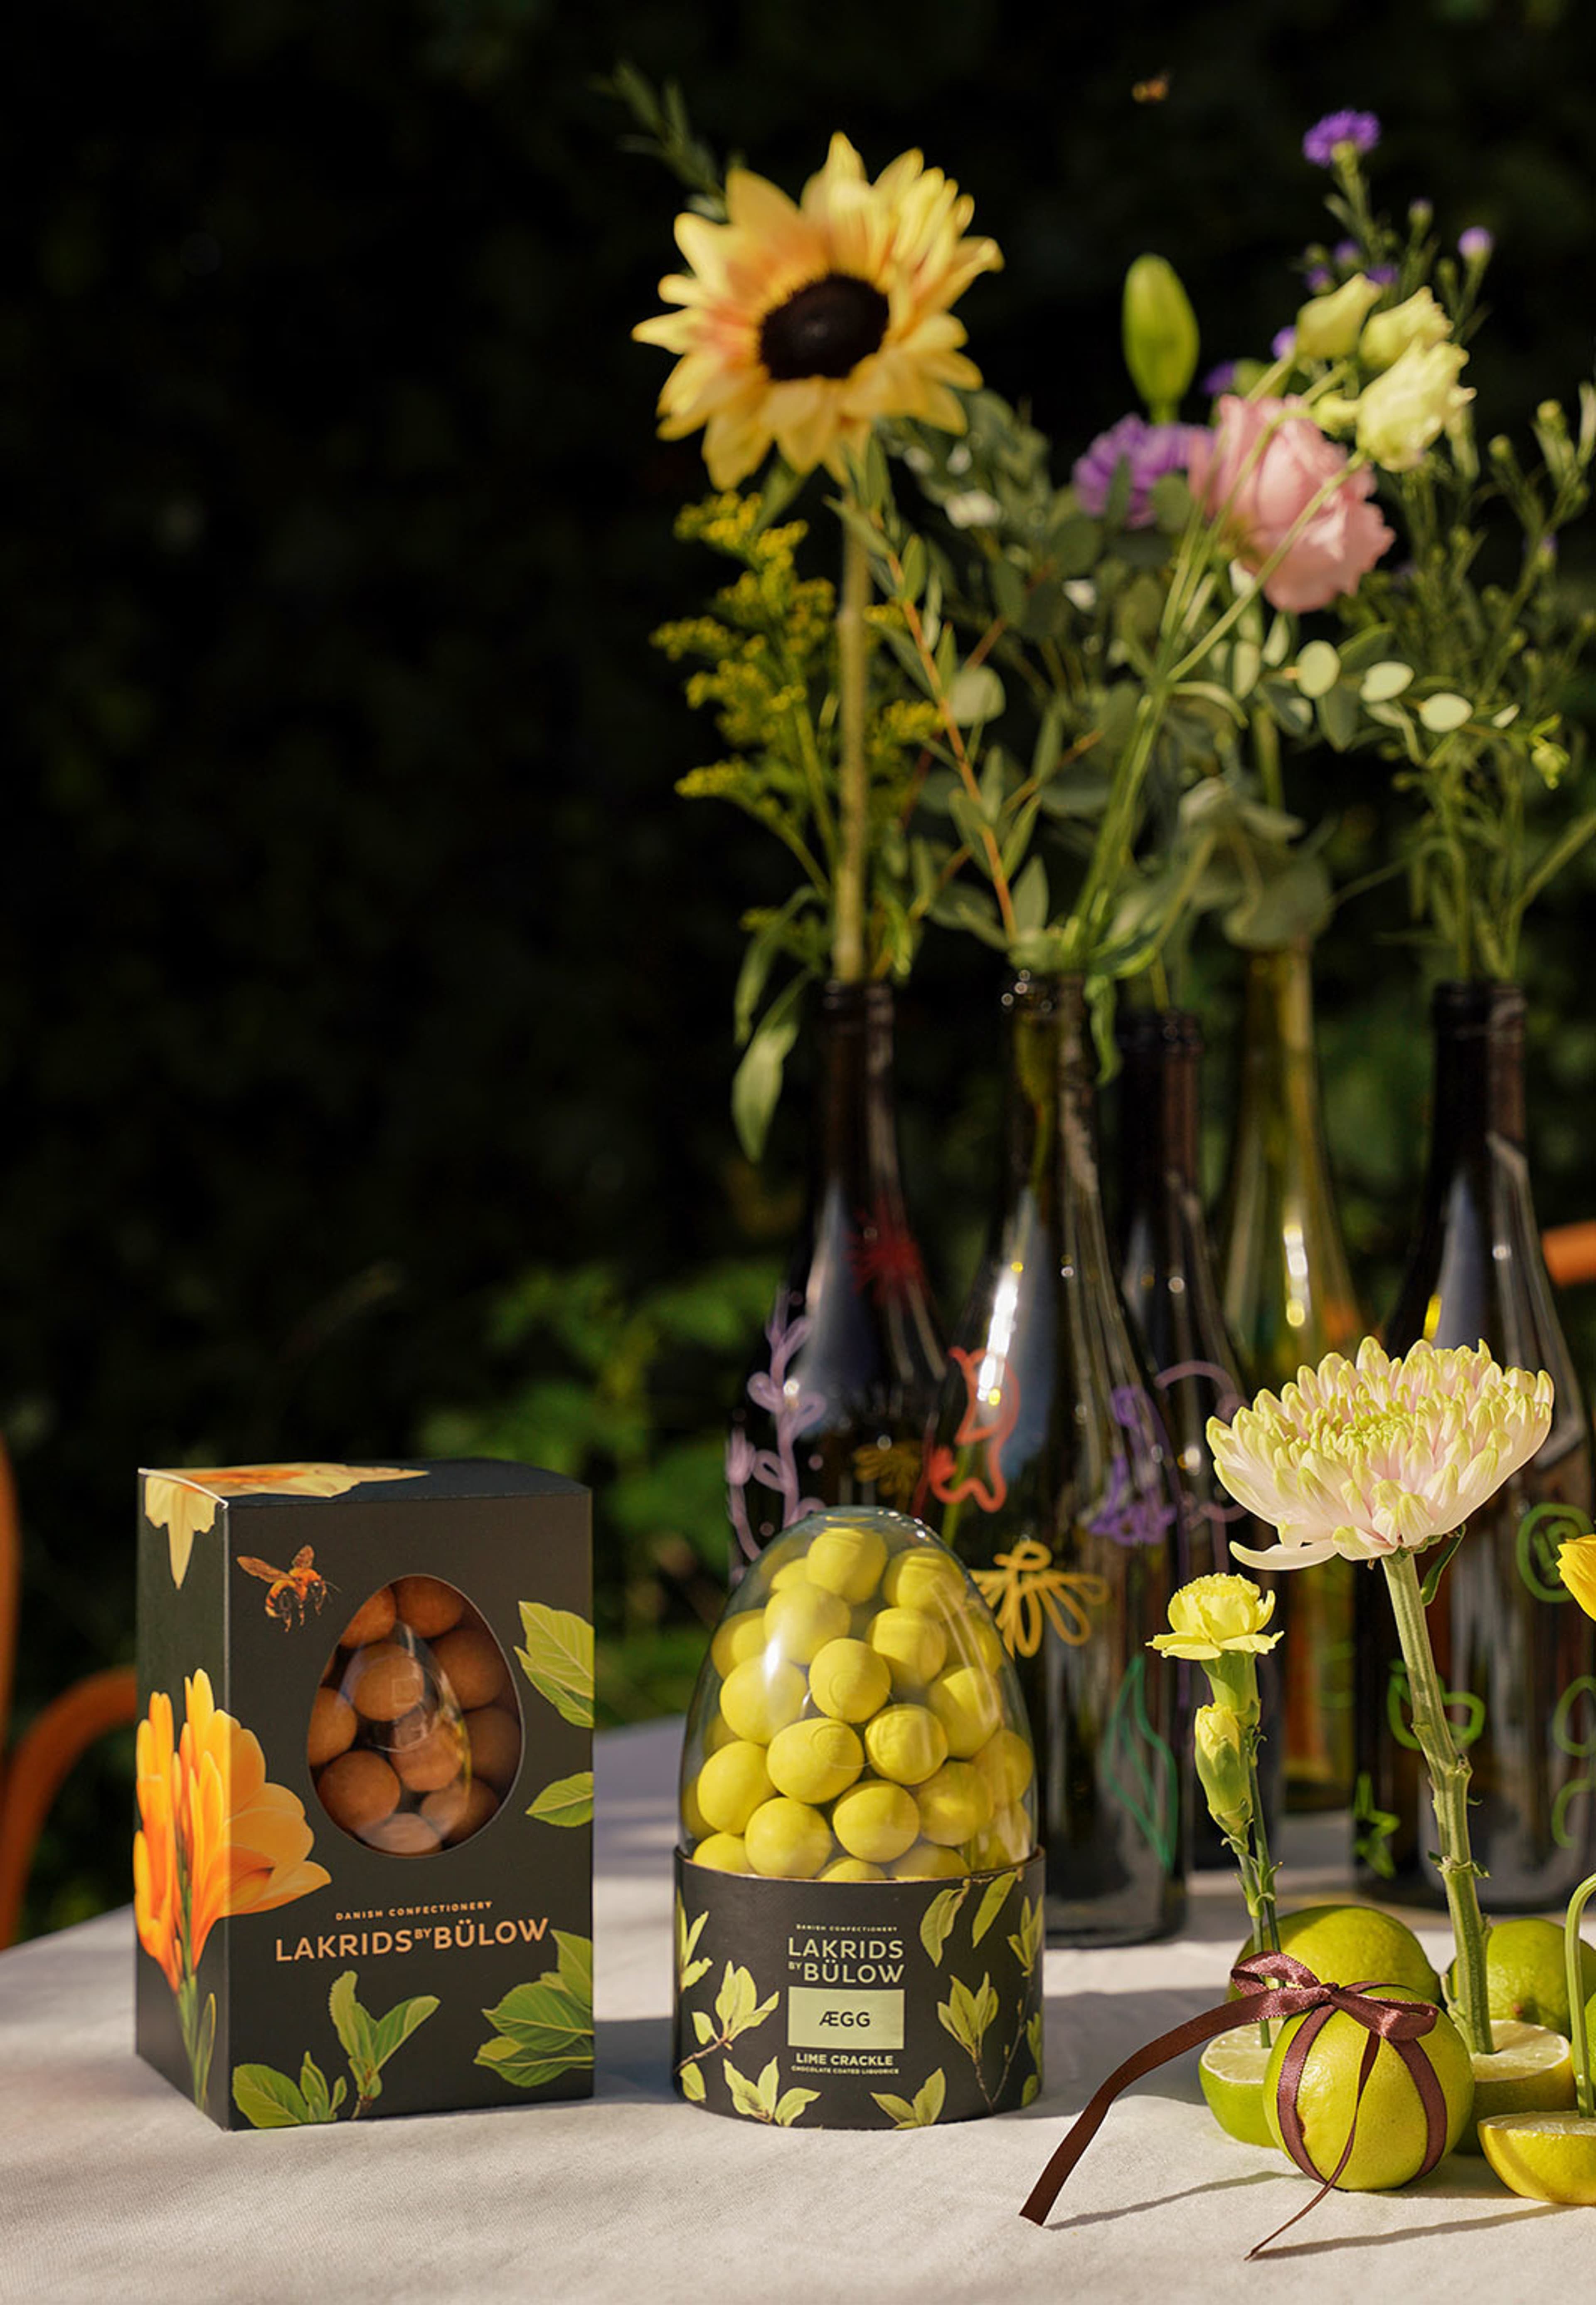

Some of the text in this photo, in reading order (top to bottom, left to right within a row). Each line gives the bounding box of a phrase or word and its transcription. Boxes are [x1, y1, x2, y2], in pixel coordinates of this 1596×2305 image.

[336, 1901, 492, 1920] DANISH CONFECTIONERY
[276, 1917, 549, 1962] LAKRIDS BY BÜLOW
[788, 1937, 904, 1959] LAKRIDS
[788, 1959, 904, 1983] BY BÜLOW
[819, 2011, 871, 2027] ÆGG
[796, 2053, 894, 2066] LIME CRACKLE
